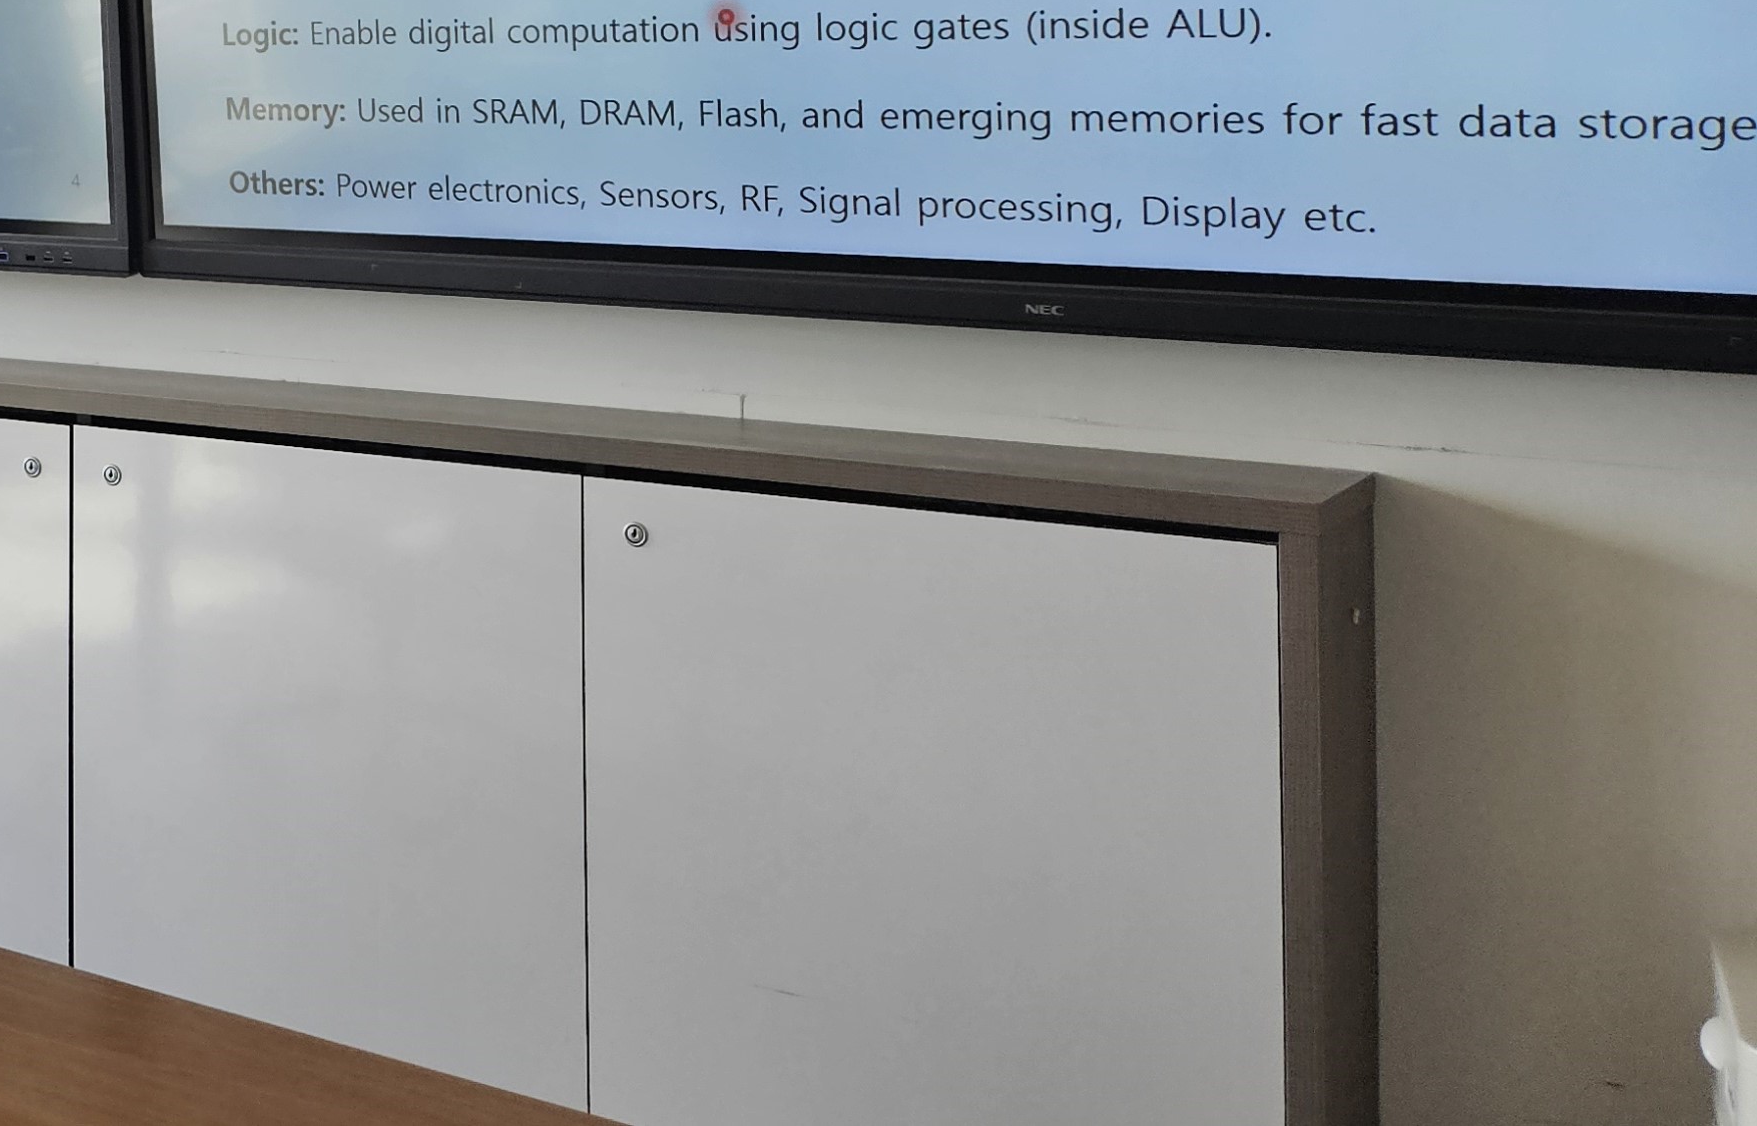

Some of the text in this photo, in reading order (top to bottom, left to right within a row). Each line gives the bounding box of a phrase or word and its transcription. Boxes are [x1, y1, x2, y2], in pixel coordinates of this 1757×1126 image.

[221, 7, 1272, 53] Logic: Enable digital computation using logic gates (inside ALU).
[225, 96, 1757, 152] Memory: Used in SRAM, DRAM, Flash, and emerging memories for fast data storage
[70, 173, 81, 189] 4
[229, 170, 1376, 239] Others: Power electronics, Sensors, RF, Signal processing, Display etc.
[1025, 303, 1065, 318] NEC
